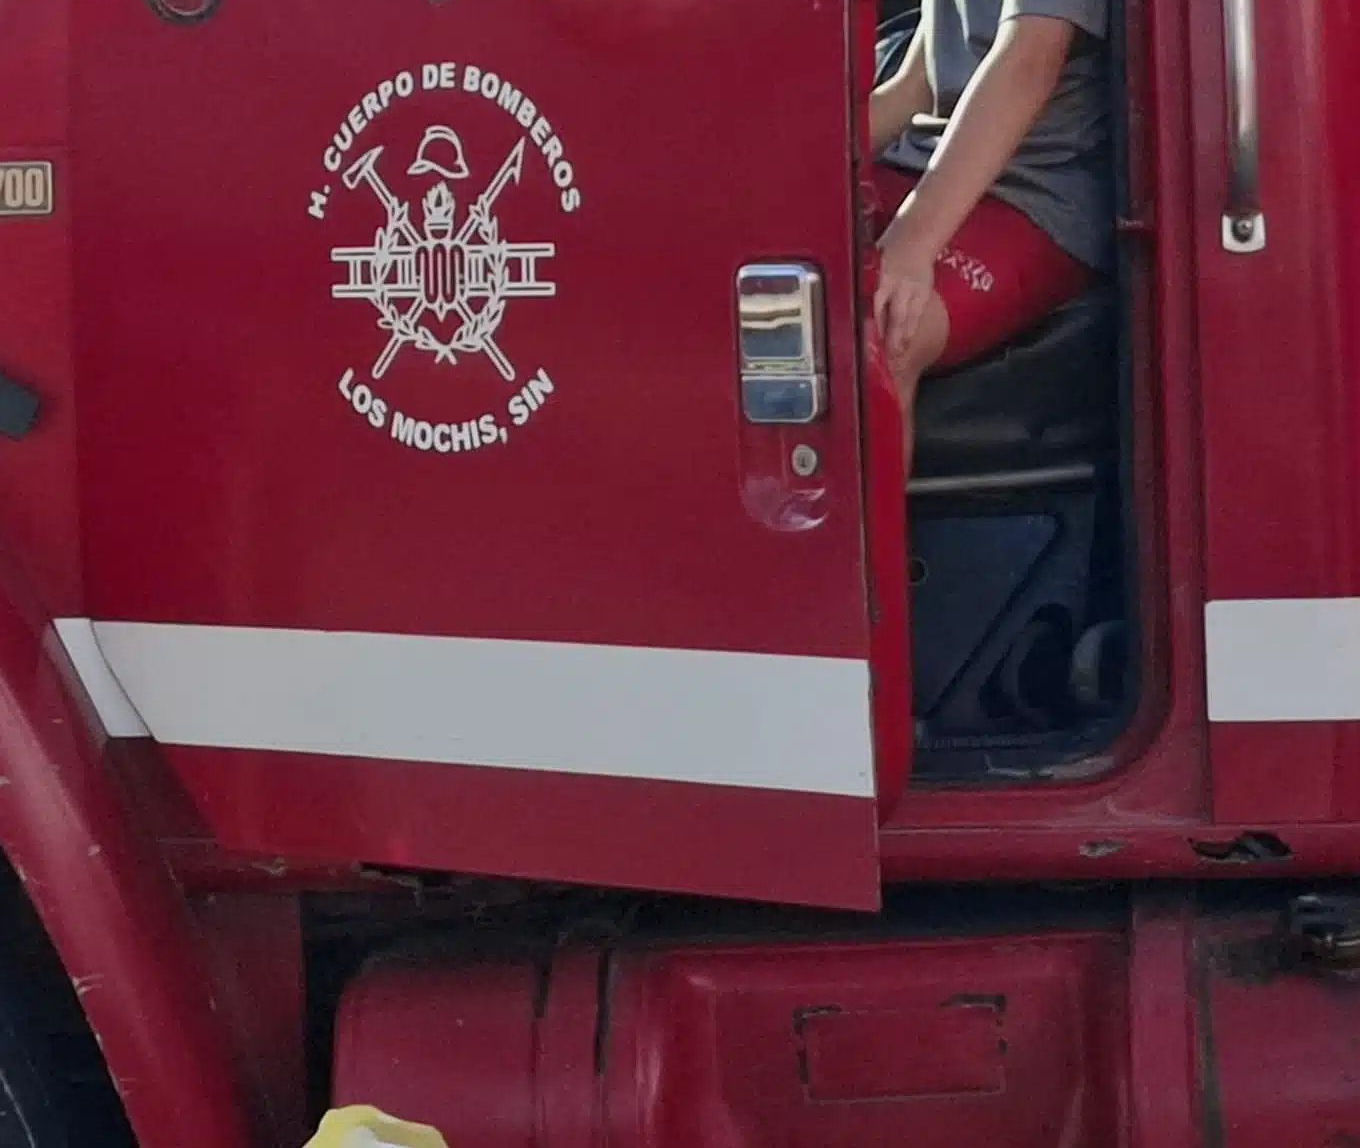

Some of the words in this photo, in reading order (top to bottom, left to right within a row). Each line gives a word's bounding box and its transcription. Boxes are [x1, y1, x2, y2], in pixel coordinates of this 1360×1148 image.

[308, 185, 333, 219] H.
[324, 71, 414, 172] CUERPO
[422, 62, 456, 90] DE
[463, 66, 581, 212] BOMBEROS
[338, 368, 388, 428] LOS
[391, 412, 508, 452] MOCHIS,
[508, 368, 555, 425] SIN
